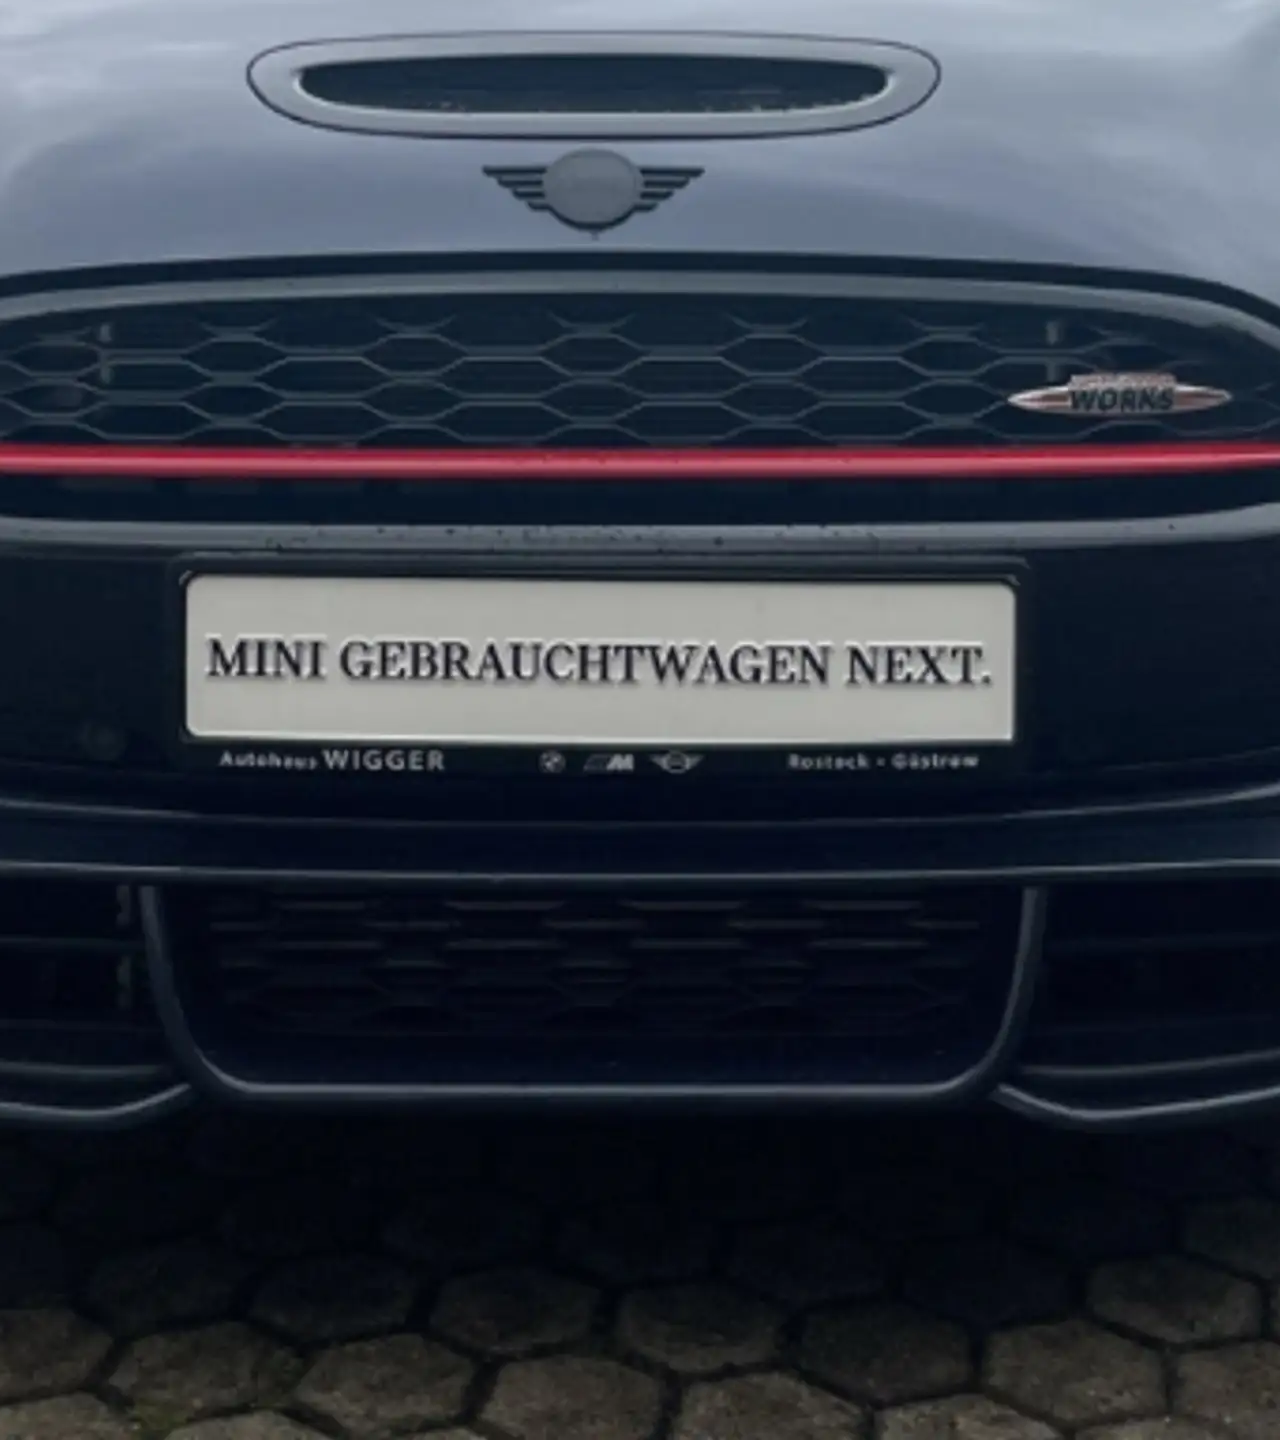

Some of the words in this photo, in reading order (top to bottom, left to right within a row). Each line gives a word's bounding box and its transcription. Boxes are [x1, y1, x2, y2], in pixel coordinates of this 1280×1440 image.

[1071, 386, 1175, 411] WORKS
[207, 638, 324, 678] MINI
[339, 639, 829, 684] GEBRAUCHTWAGEN
[846, 644, 991, 686] NEXT.
[219, 750, 317, 770] Autohaus
[322, 749, 445, 771] WIGGER
